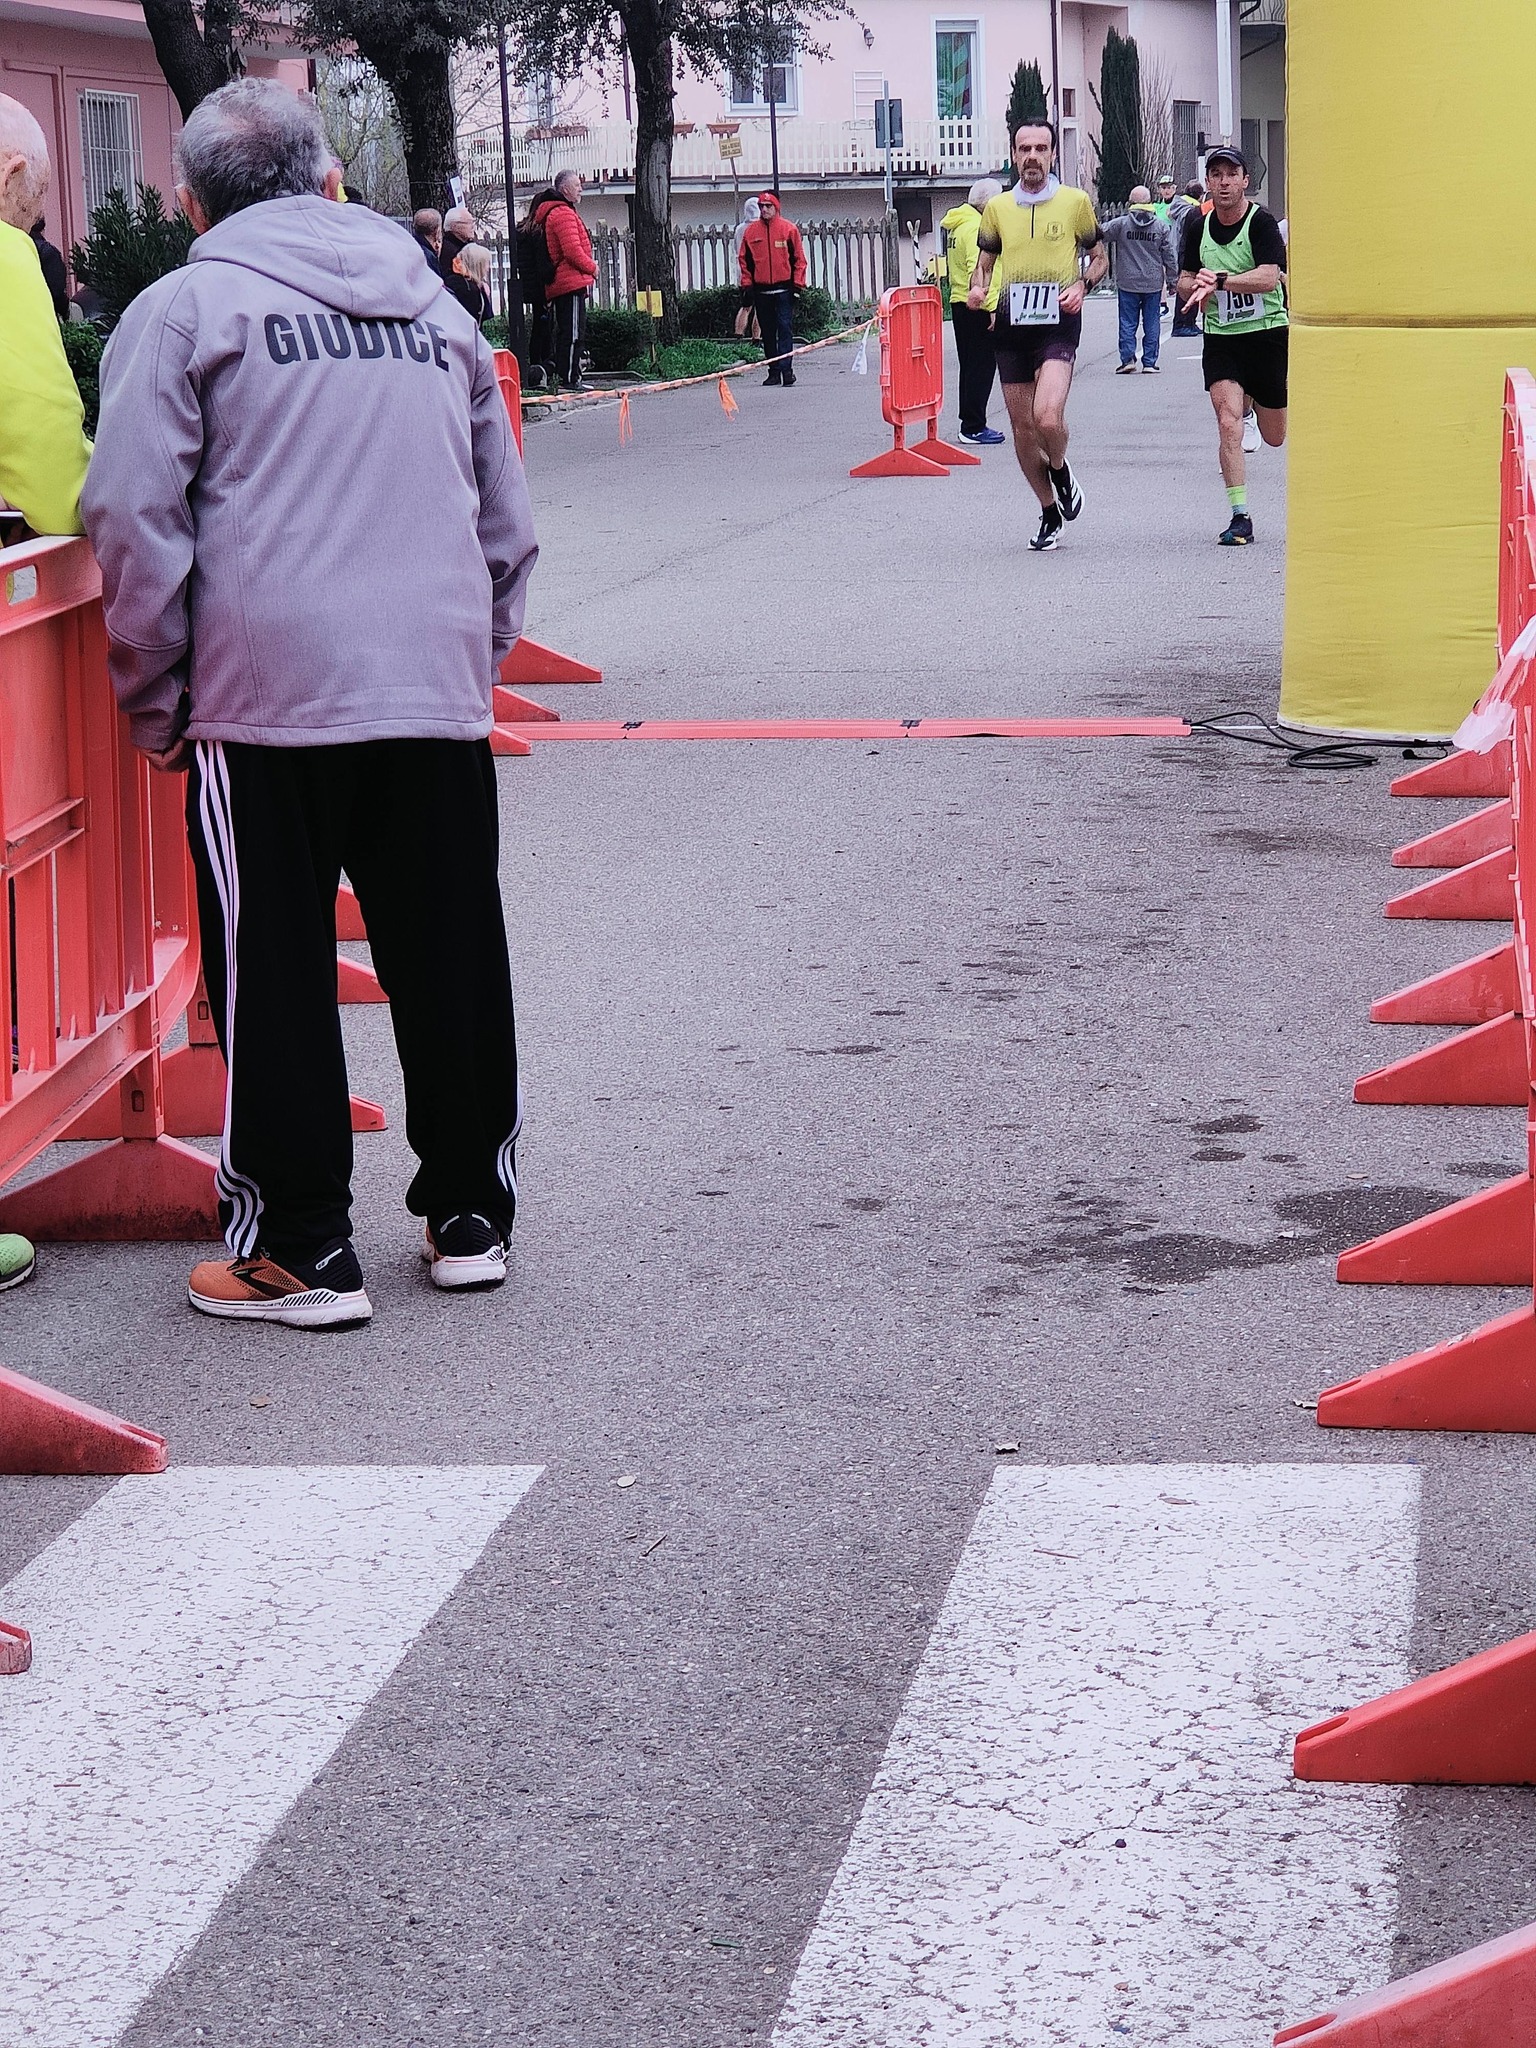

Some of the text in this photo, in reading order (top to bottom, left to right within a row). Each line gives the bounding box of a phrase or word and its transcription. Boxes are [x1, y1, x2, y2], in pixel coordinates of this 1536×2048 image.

[1126, 230, 1157, 242] GIUDICE
[1022, 285, 1050, 310] 777
[263, 313, 450, 373] GIUDICE
